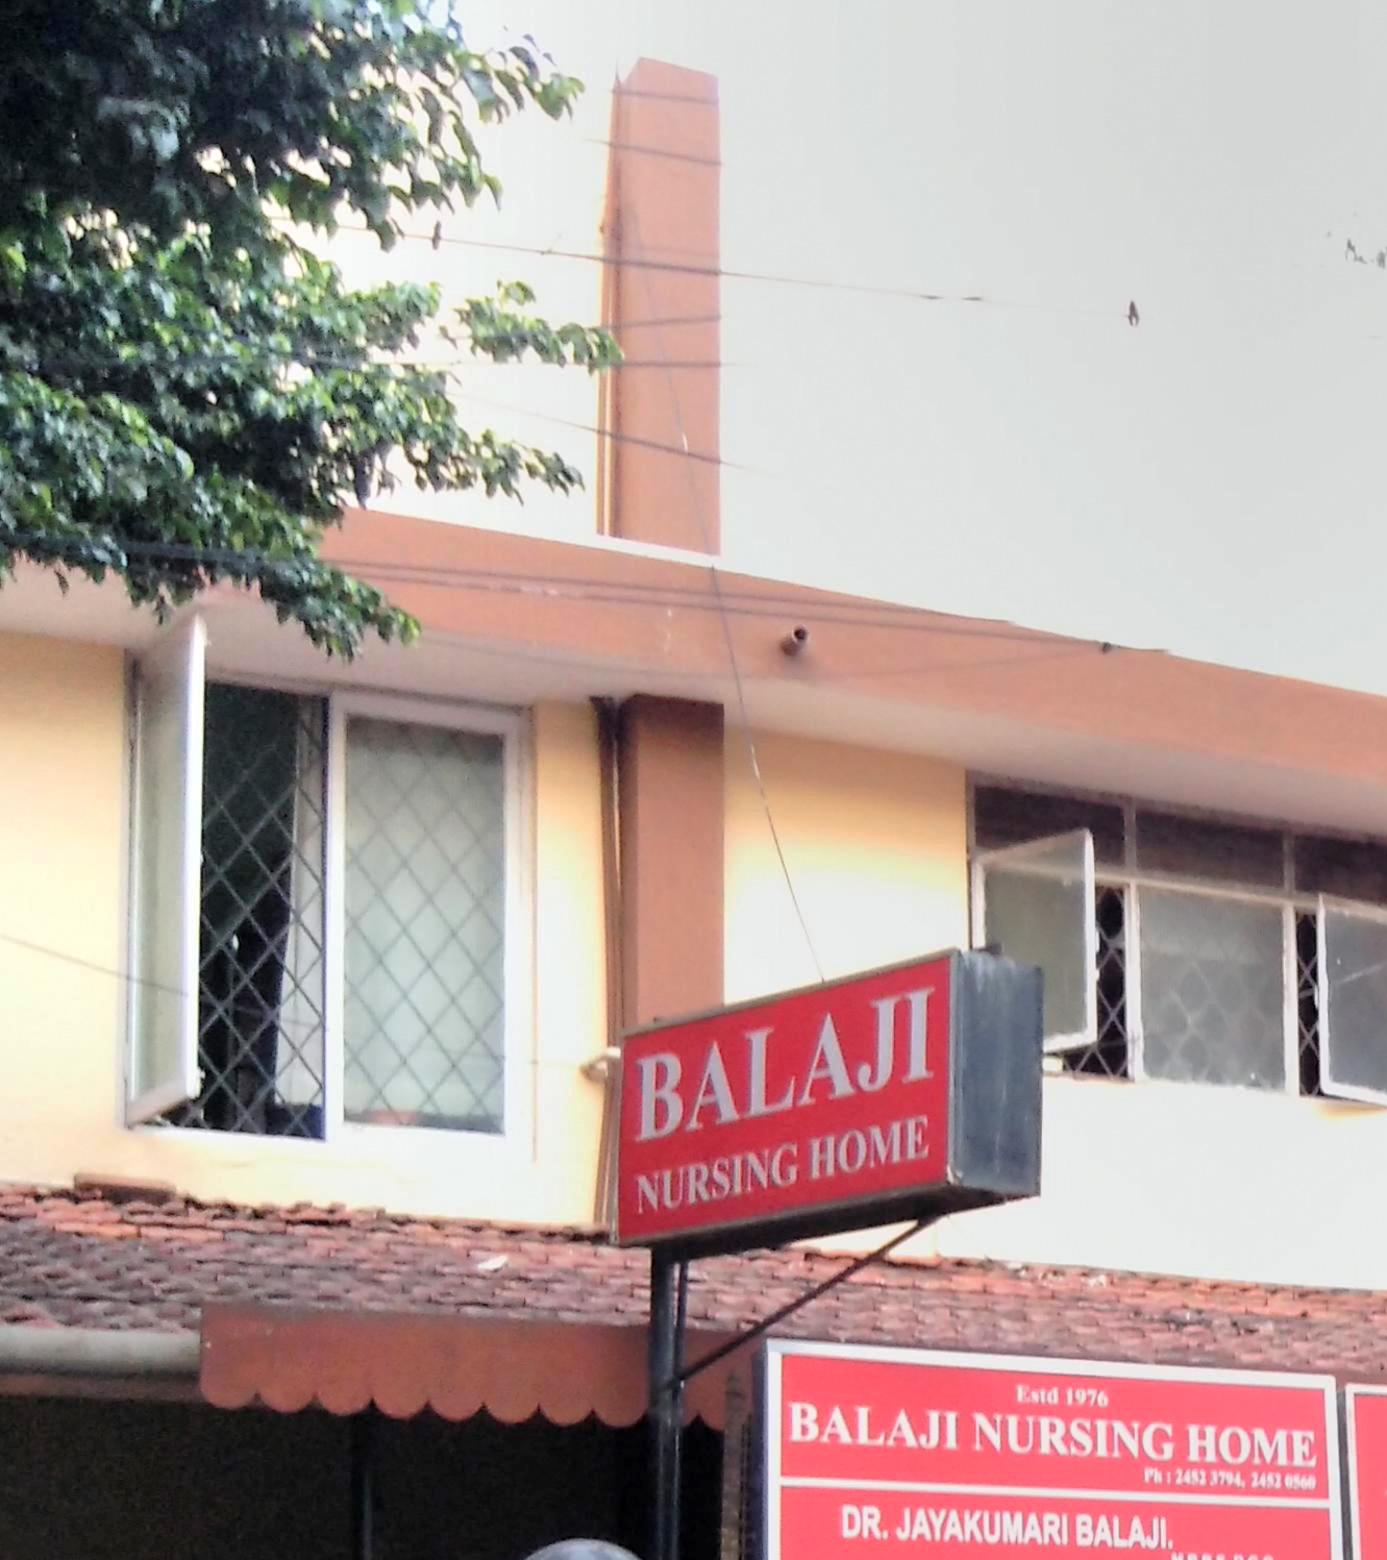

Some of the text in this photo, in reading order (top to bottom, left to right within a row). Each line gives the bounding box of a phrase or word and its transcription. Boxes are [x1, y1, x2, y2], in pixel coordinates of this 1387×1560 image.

[635, 986, 934, 1142] BALAJI
[637, 1115, 929, 1214] NURSING HOME
[1016, 1384, 1109, 1408] Estd 1976
[789, 1402, 1317, 1467] BALAJI NURSING HOME
[1144, 1467, 1163, 1484] Ph
[1175, 1468, 1207, 1487] 2452
[842, 1504, 1174, 1550] DR. JAYAKUMARI BALAJI.
